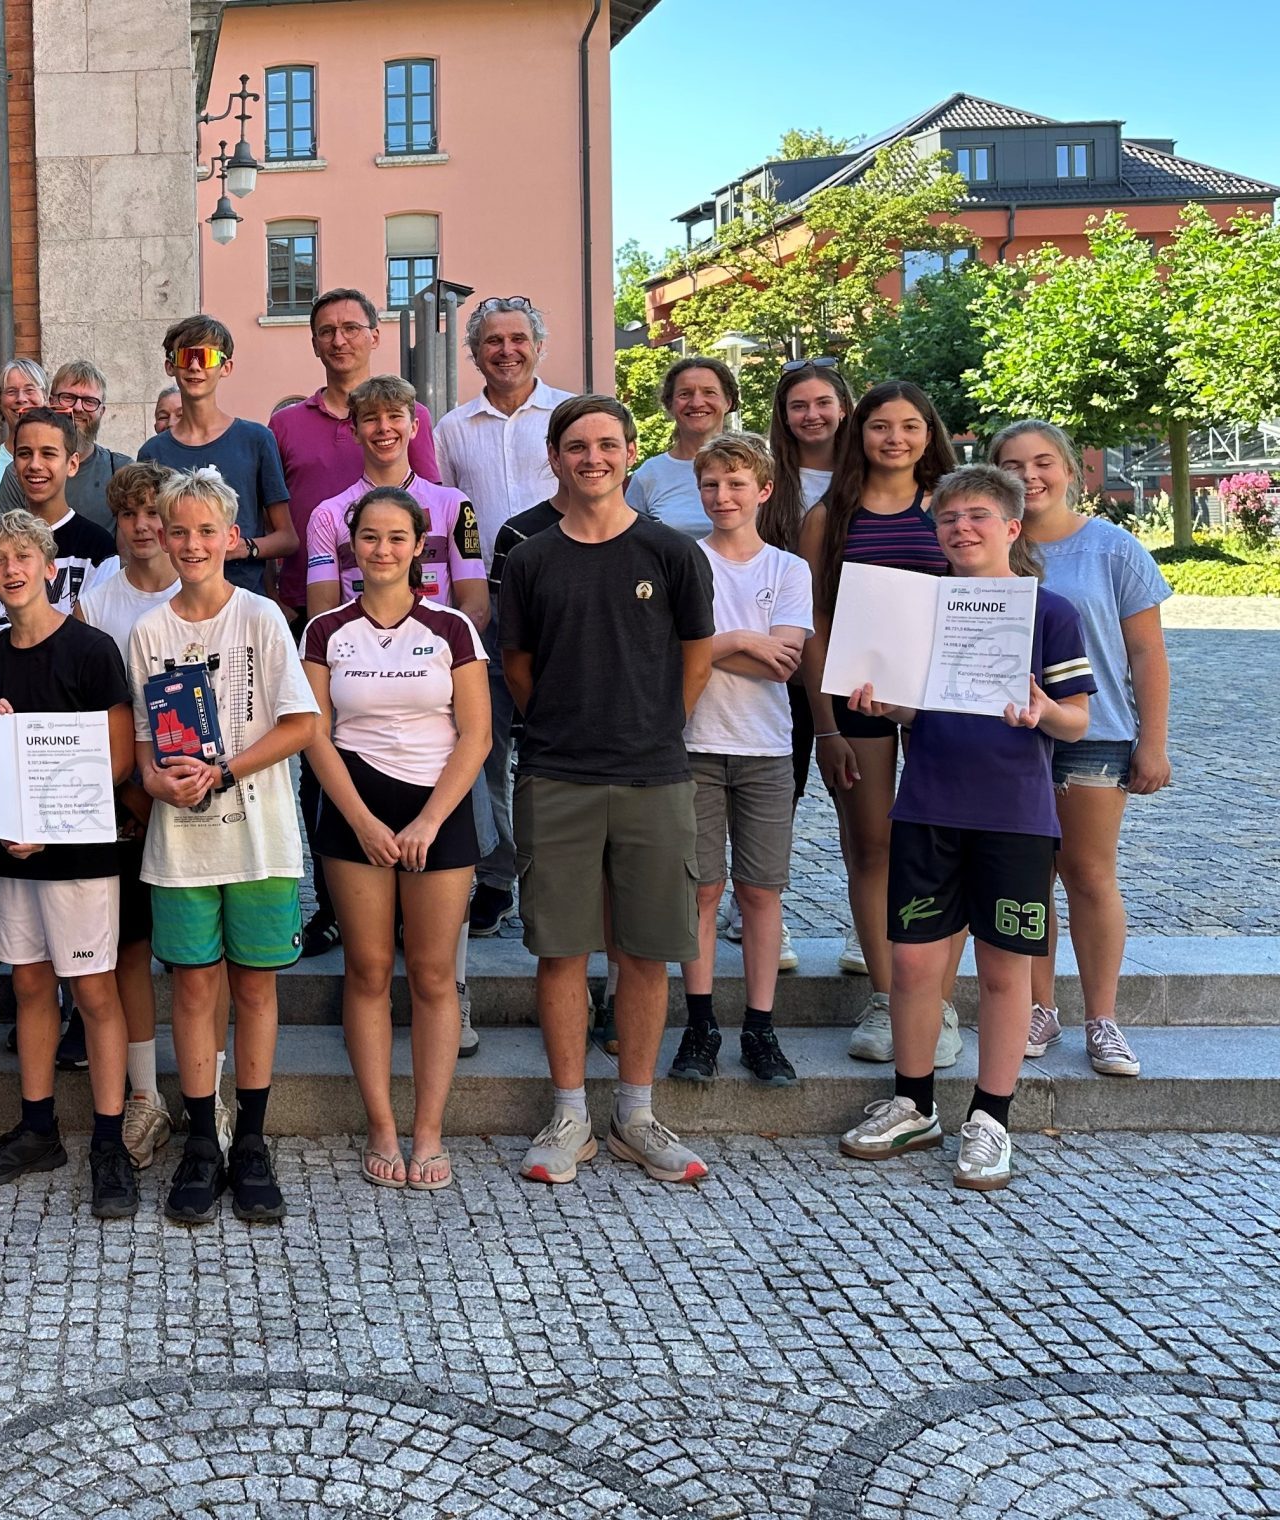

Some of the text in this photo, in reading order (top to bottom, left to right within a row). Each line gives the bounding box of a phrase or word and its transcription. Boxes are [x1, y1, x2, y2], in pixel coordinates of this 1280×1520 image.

[947, 601, 1006, 613] URKUNDE
[412, 646, 434, 656] 09
[344, 670, 428, 678] FIRST LEAGUE
[246, 646, 254, 722] SKATE DAYS
[26, 735, 80, 746] URKUNDE
[995, 898, 1046, 941] 63
[72, 951, 94, 959] JAKO
